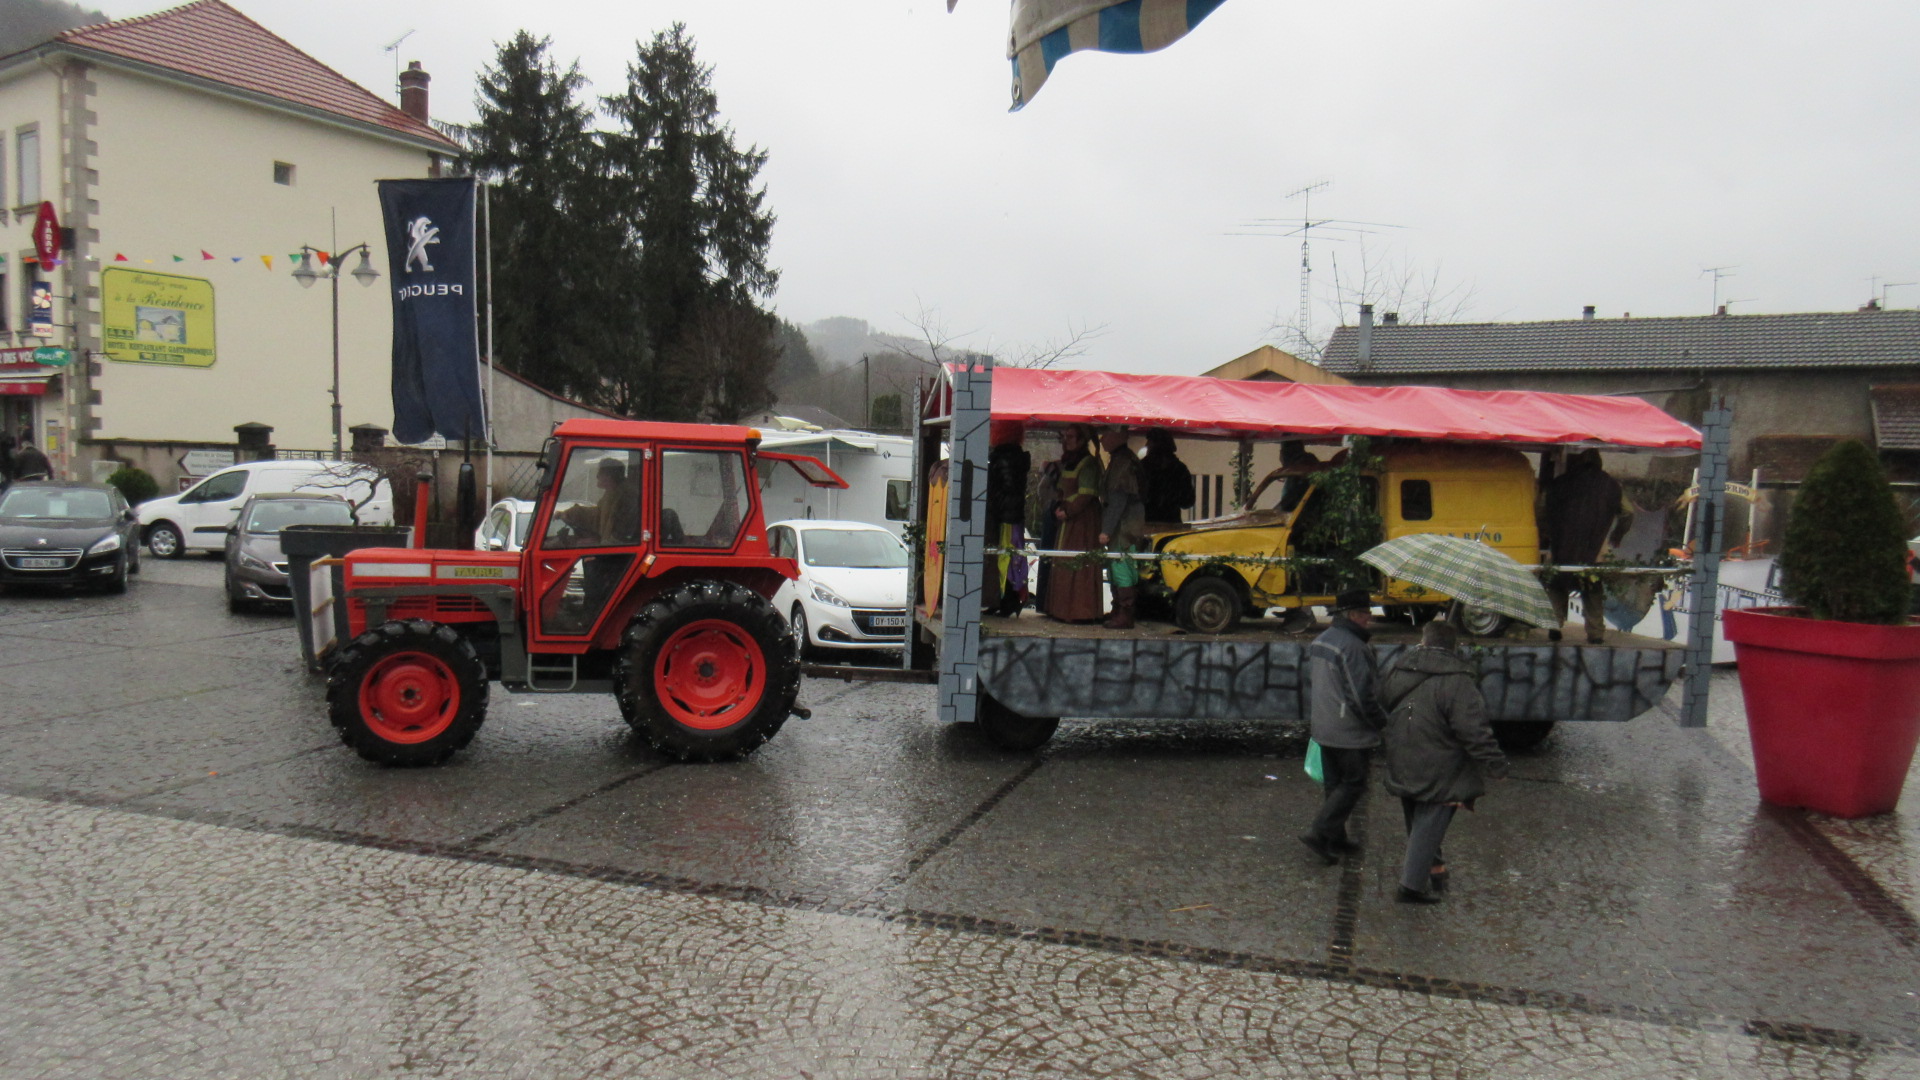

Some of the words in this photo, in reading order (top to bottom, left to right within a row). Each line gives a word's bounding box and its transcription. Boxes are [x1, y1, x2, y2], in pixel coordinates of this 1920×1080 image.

[44, 220, 53, 254] TABAC
[454, 567, 503, 577] TAURUS
[875, 617, 905, 626] DY-150-X
